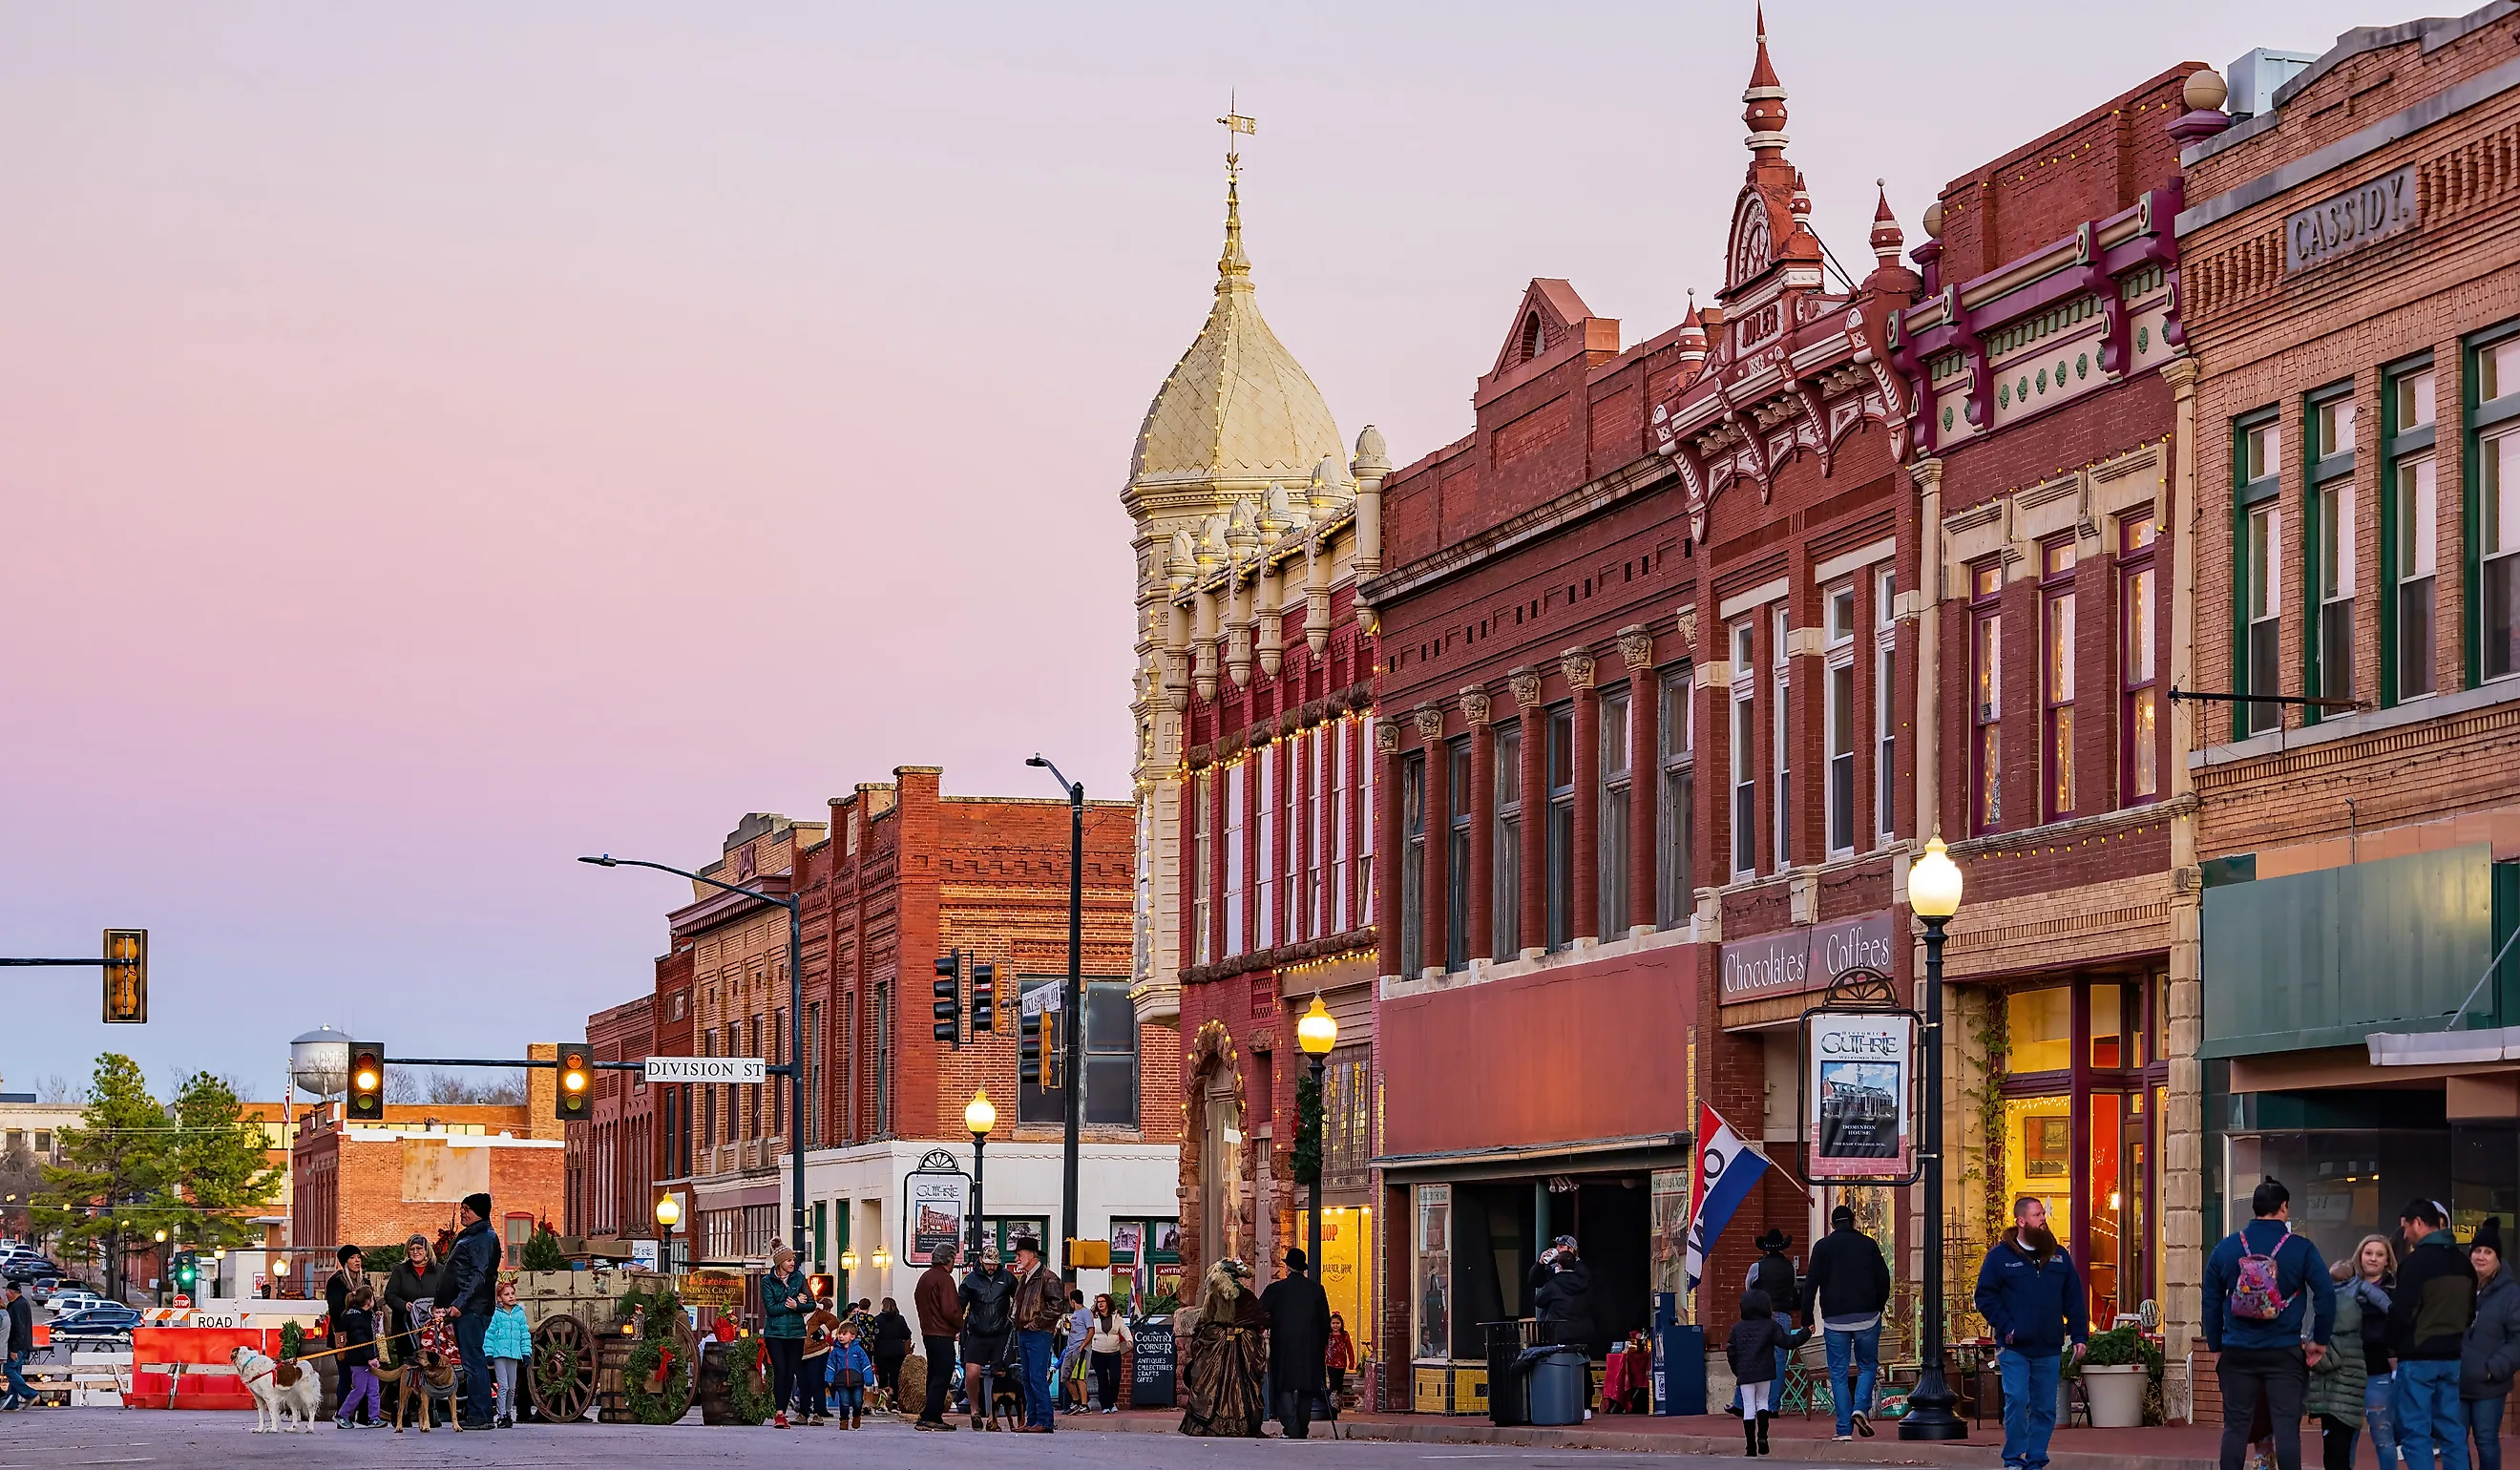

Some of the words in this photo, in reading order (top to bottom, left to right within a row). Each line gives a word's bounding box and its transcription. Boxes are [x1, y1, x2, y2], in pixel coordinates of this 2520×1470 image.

[1725, 943, 1804, 993] Chocolates
[1826, 926, 1890, 976] Coffees
[1821, 1032, 1899, 1056] GUTHRIE
[647, 1061, 734, 1076] DIVISION
[744, 1064, 764, 1077] ST
[916, 1185, 959, 1198] GUTHRIE
[1321, 1224, 1338, 1241] HOP
[198, 1316, 233, 1328] ROAD
[1134, 1331, 1174, 1342] COUNTRY
[1136, 1343, 1172, 1354] CORNER
